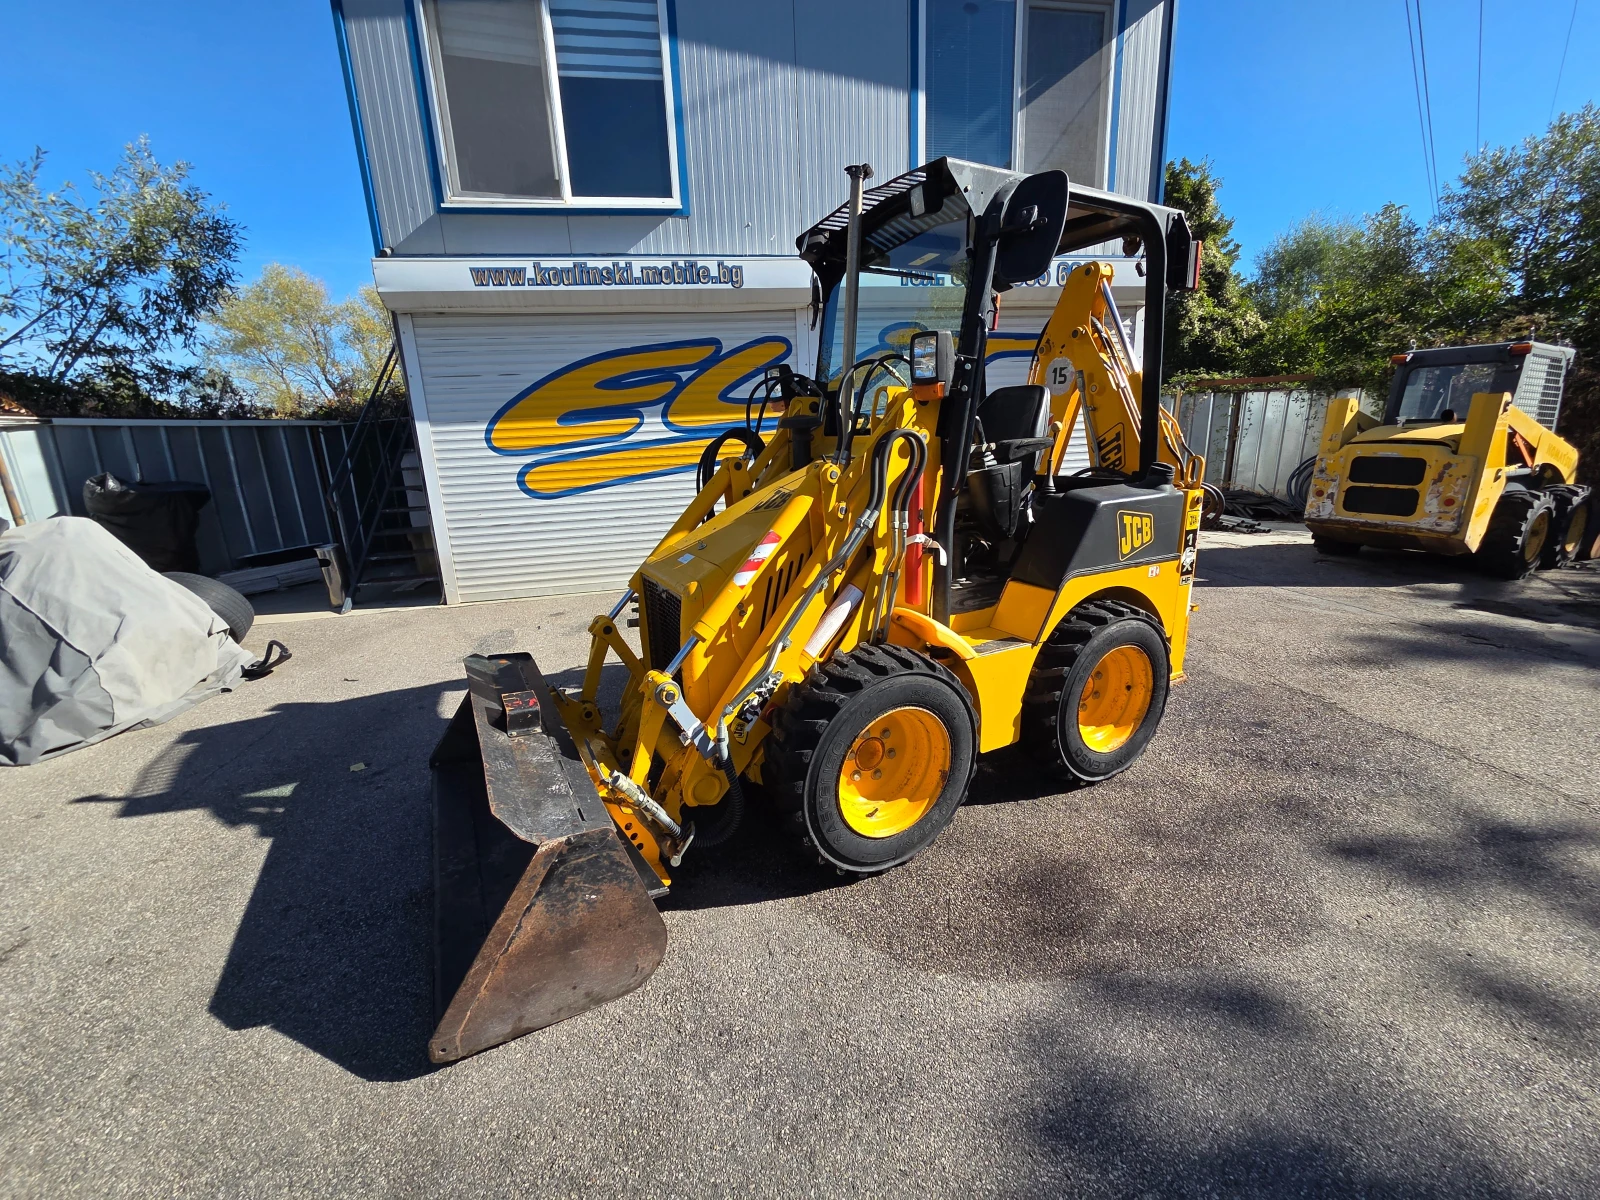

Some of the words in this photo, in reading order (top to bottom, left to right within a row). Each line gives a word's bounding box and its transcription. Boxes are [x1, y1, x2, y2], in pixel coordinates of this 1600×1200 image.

[469, 261, 744, 288] www.koulinski.mobile.bg
[1051, 366, 1068, 385] 15
[750, 489, 792, 511] JCB
[1121, 514, 1152, 555] JCB
